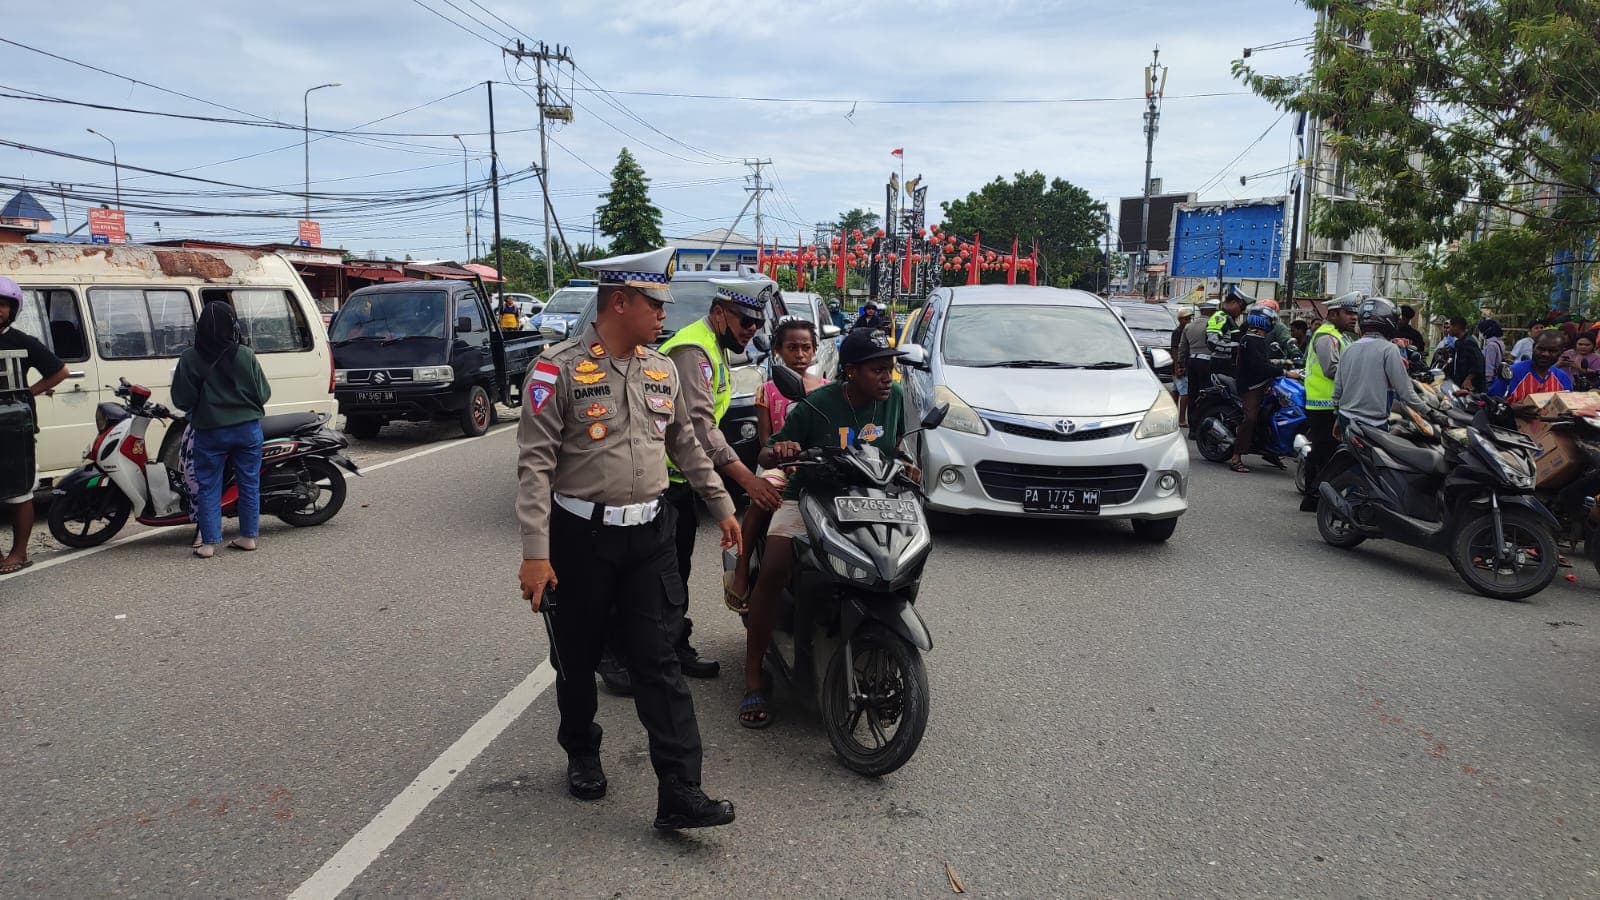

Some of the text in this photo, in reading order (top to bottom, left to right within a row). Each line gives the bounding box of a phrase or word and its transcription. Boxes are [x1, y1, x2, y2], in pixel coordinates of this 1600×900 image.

[574, 385, 611, 399] DARWIS
[644, 383, 671, 395] POLRI
[1025, 489, 1098, 504] PA 1775 MM
[839, 499, 857, 511] PA
[861, 500, 893, 510] 2655
